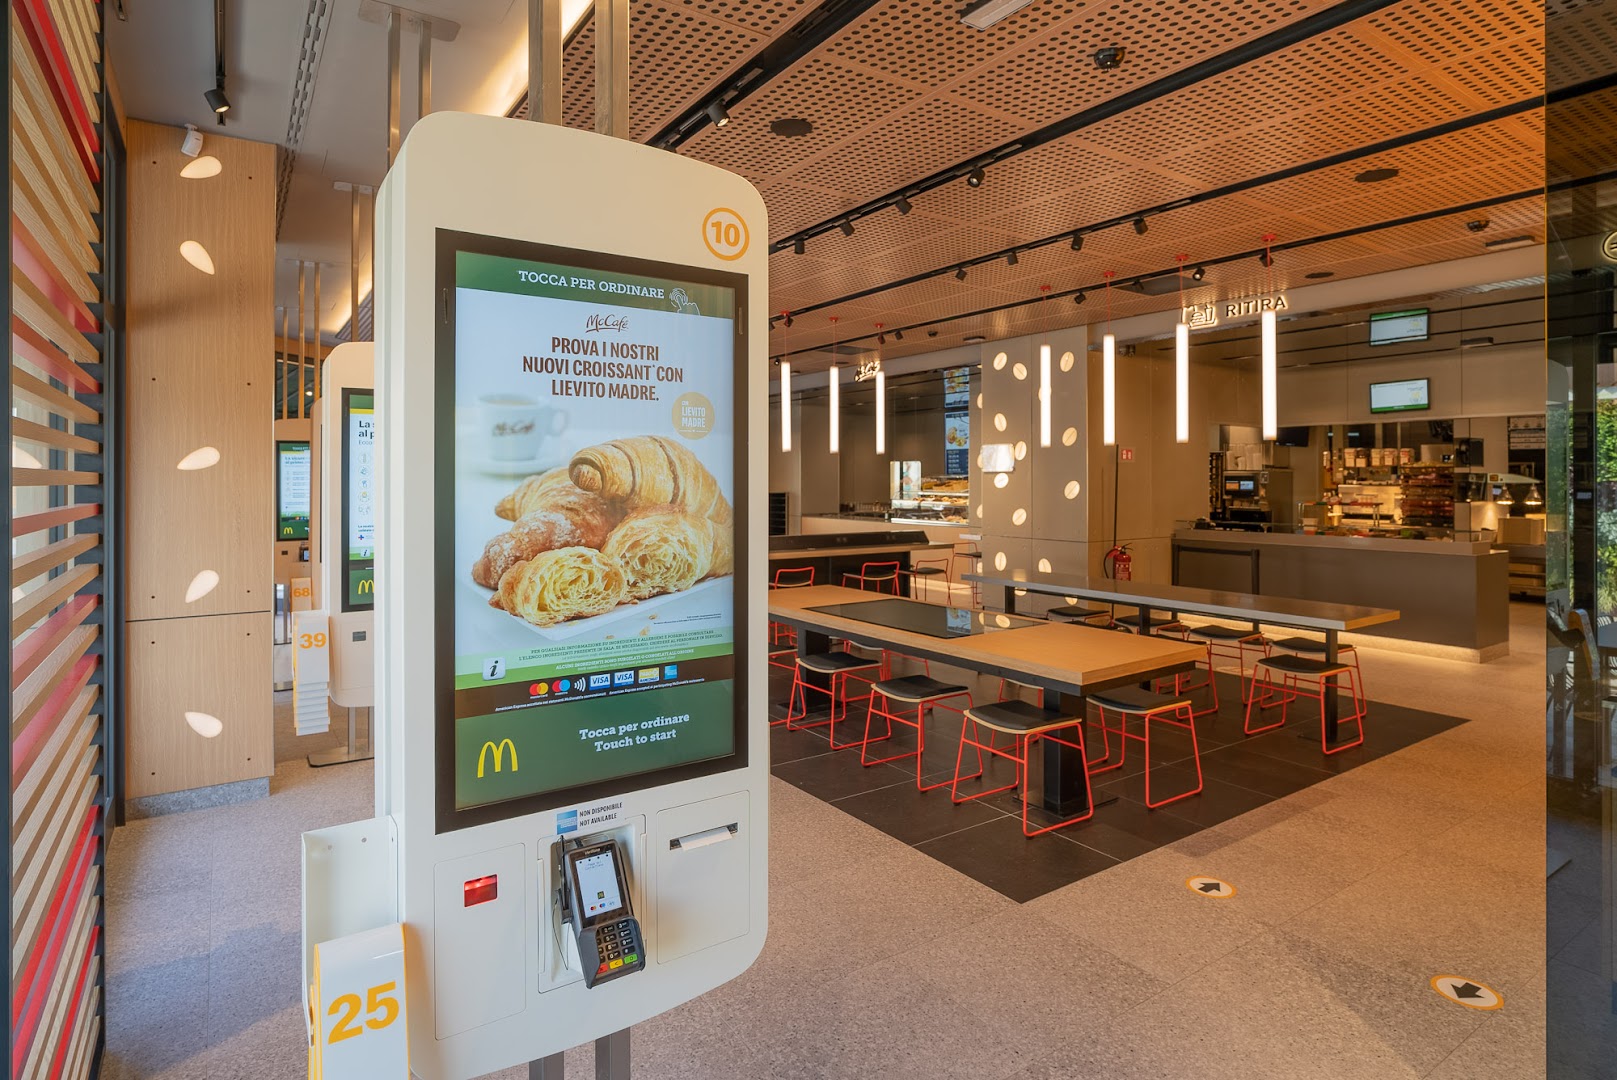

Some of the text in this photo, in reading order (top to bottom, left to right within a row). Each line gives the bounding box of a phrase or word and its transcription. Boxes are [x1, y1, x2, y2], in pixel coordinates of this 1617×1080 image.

[711, 221, 740, 247] 10
[519, 270, 664, 299] TOCCA PER ORDINARE
[1225, 296, 1286, 317] RITIRA
[552, 336, 658, 360] PROVA I NOSTRI
[523, 356, 568, 374] NUOVI
[656, 366, 682, 382] CON
[552, 380, 658, 401] LIEVITO MADRE.
[682, 406, 706, 416] LIEVITO
[682, 417, 706, 428] MADRE
[294, 588, 310, 598] 68
[300, 633, 326, 649] 39
[616, 673, 632, 681] VISA
[579, 714, 690, 740] Tocca per ordinare
[594, 729, 676, 752] Touch to start
[591, 812, 617, 824] AVAILABLE
[592, 802, 622, 814] DISPONIBILE
[328, 980, 400, 1045] 25
